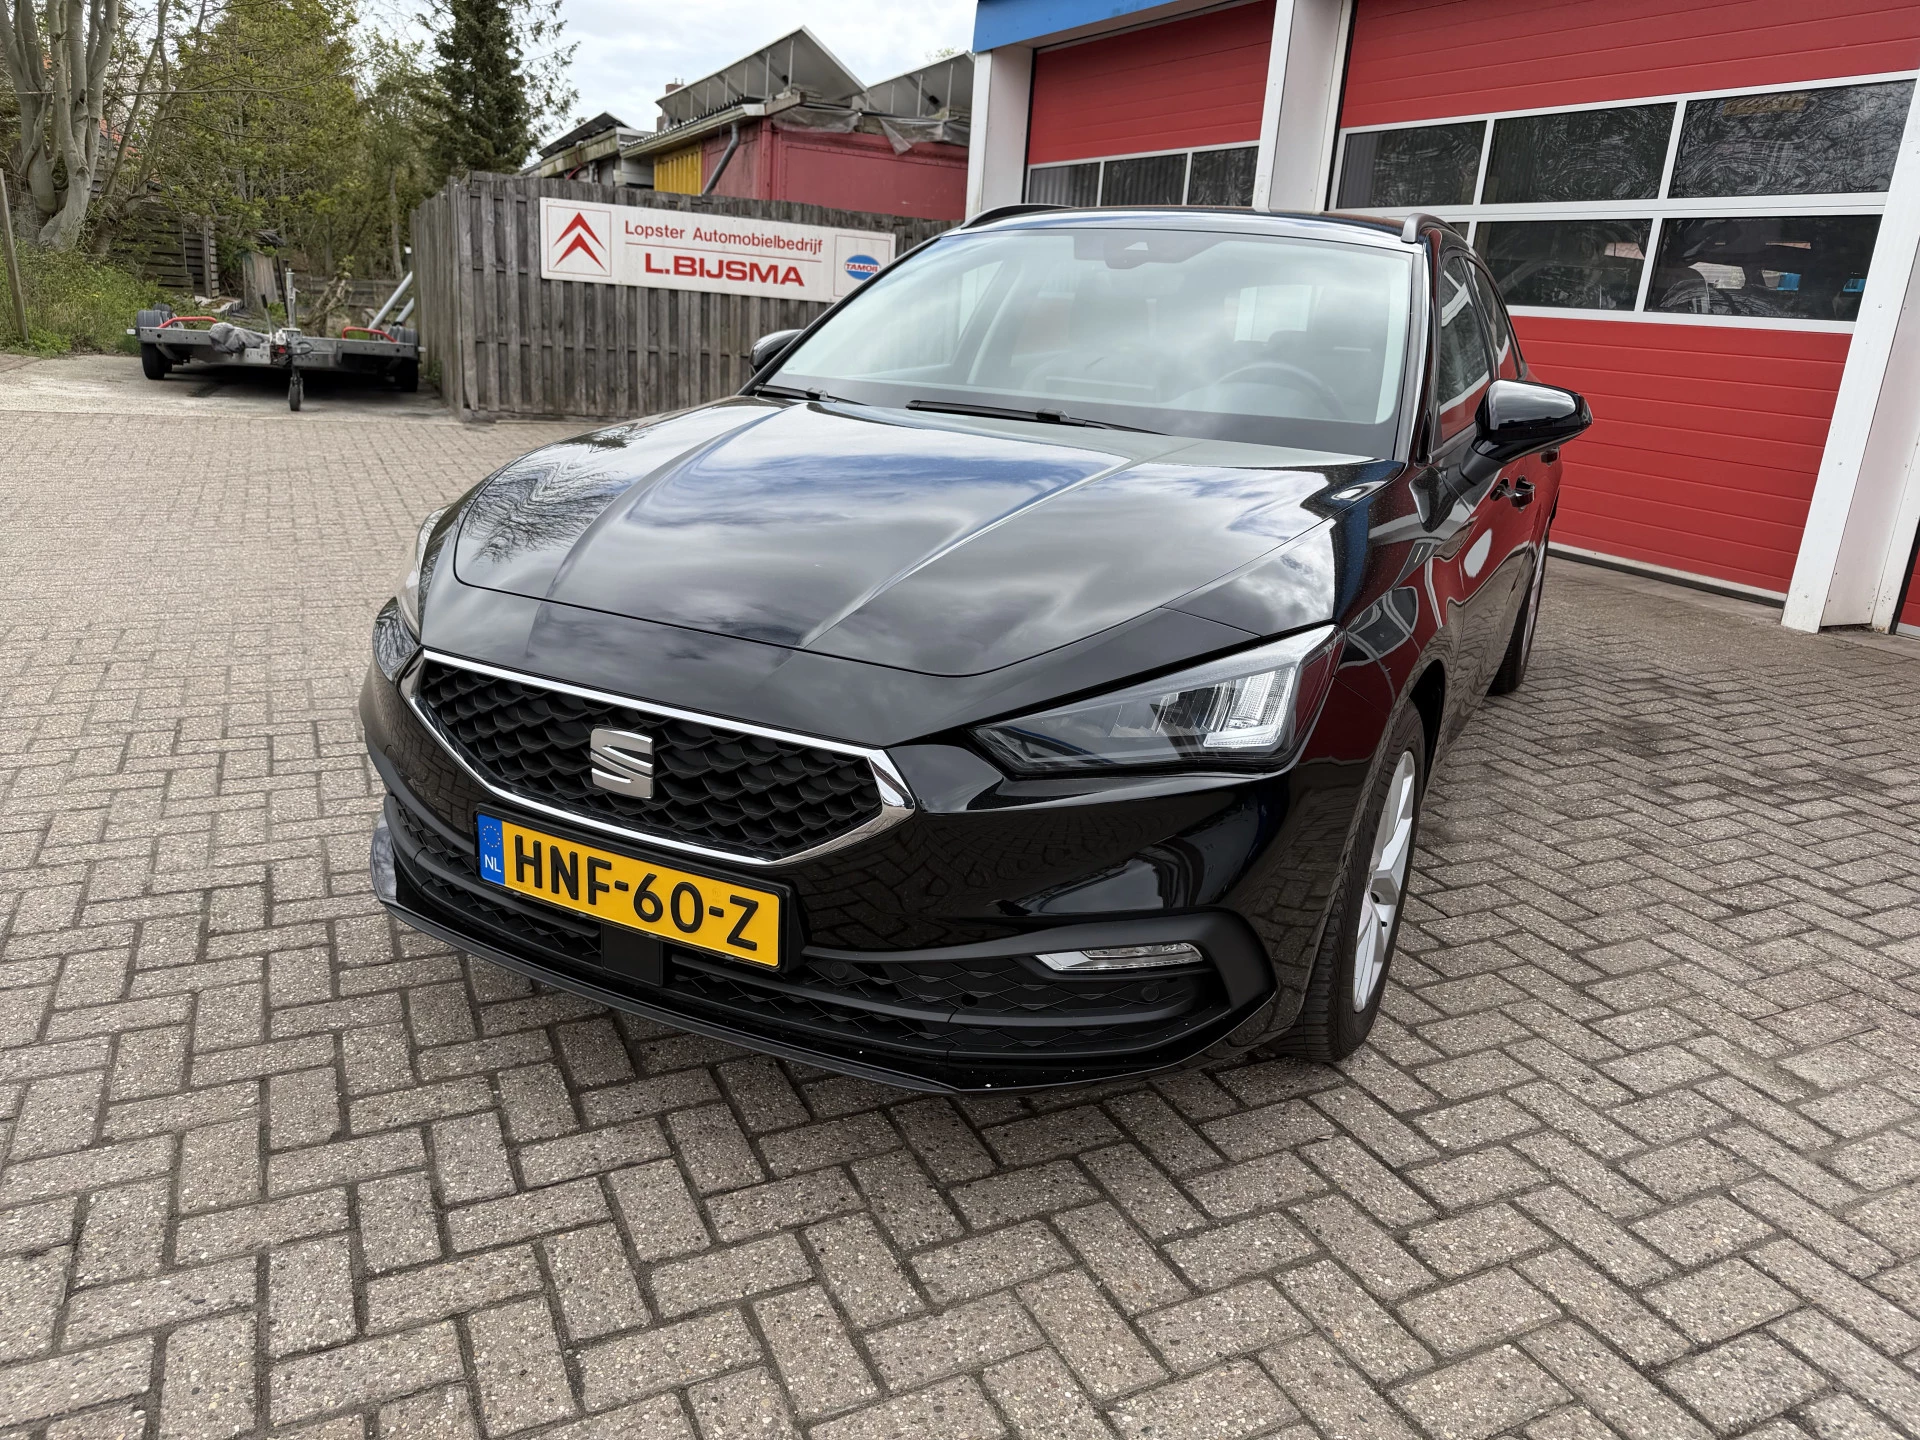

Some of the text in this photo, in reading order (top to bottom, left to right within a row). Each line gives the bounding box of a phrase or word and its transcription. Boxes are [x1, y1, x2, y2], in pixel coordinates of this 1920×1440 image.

[625, 220, 823, 255] Lopster Automobielbedrijf
[645, 253, 805, 287] L.BIJSMA
[484, 854, 501, 872] NL
[514, 834, 759, 952] HNF-60-Z
